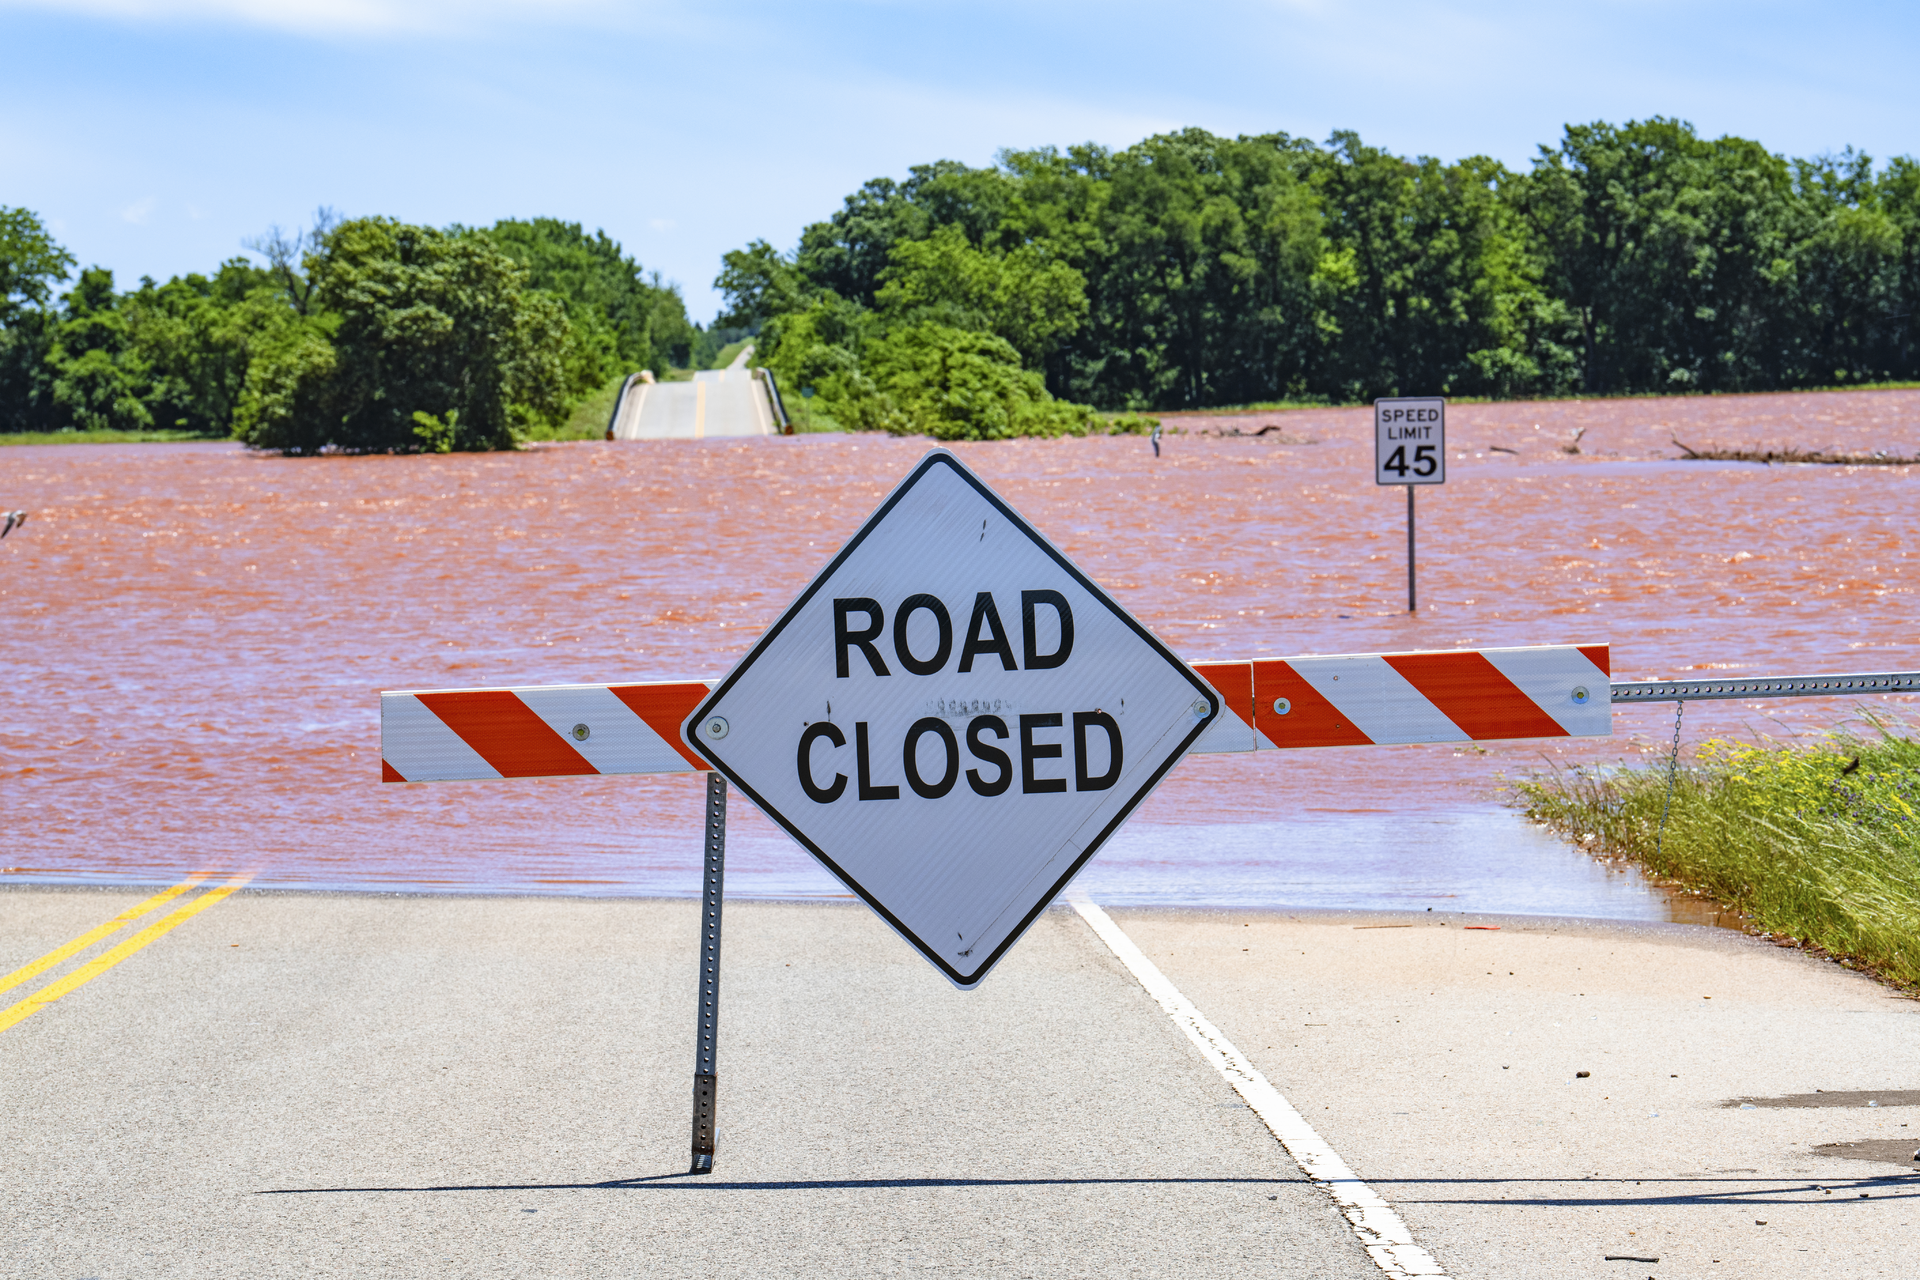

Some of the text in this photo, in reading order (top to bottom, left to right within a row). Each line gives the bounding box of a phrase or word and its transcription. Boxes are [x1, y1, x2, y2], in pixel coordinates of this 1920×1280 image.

[1382, 409, 1439, 422] SPEED
[1388, 426, 1432, 439] LIMIT
[1383, 445, 1437, 477] 45
[833, 589, 1075, 678] ROAD
[797, 711, 1124, 804] CLOSED
